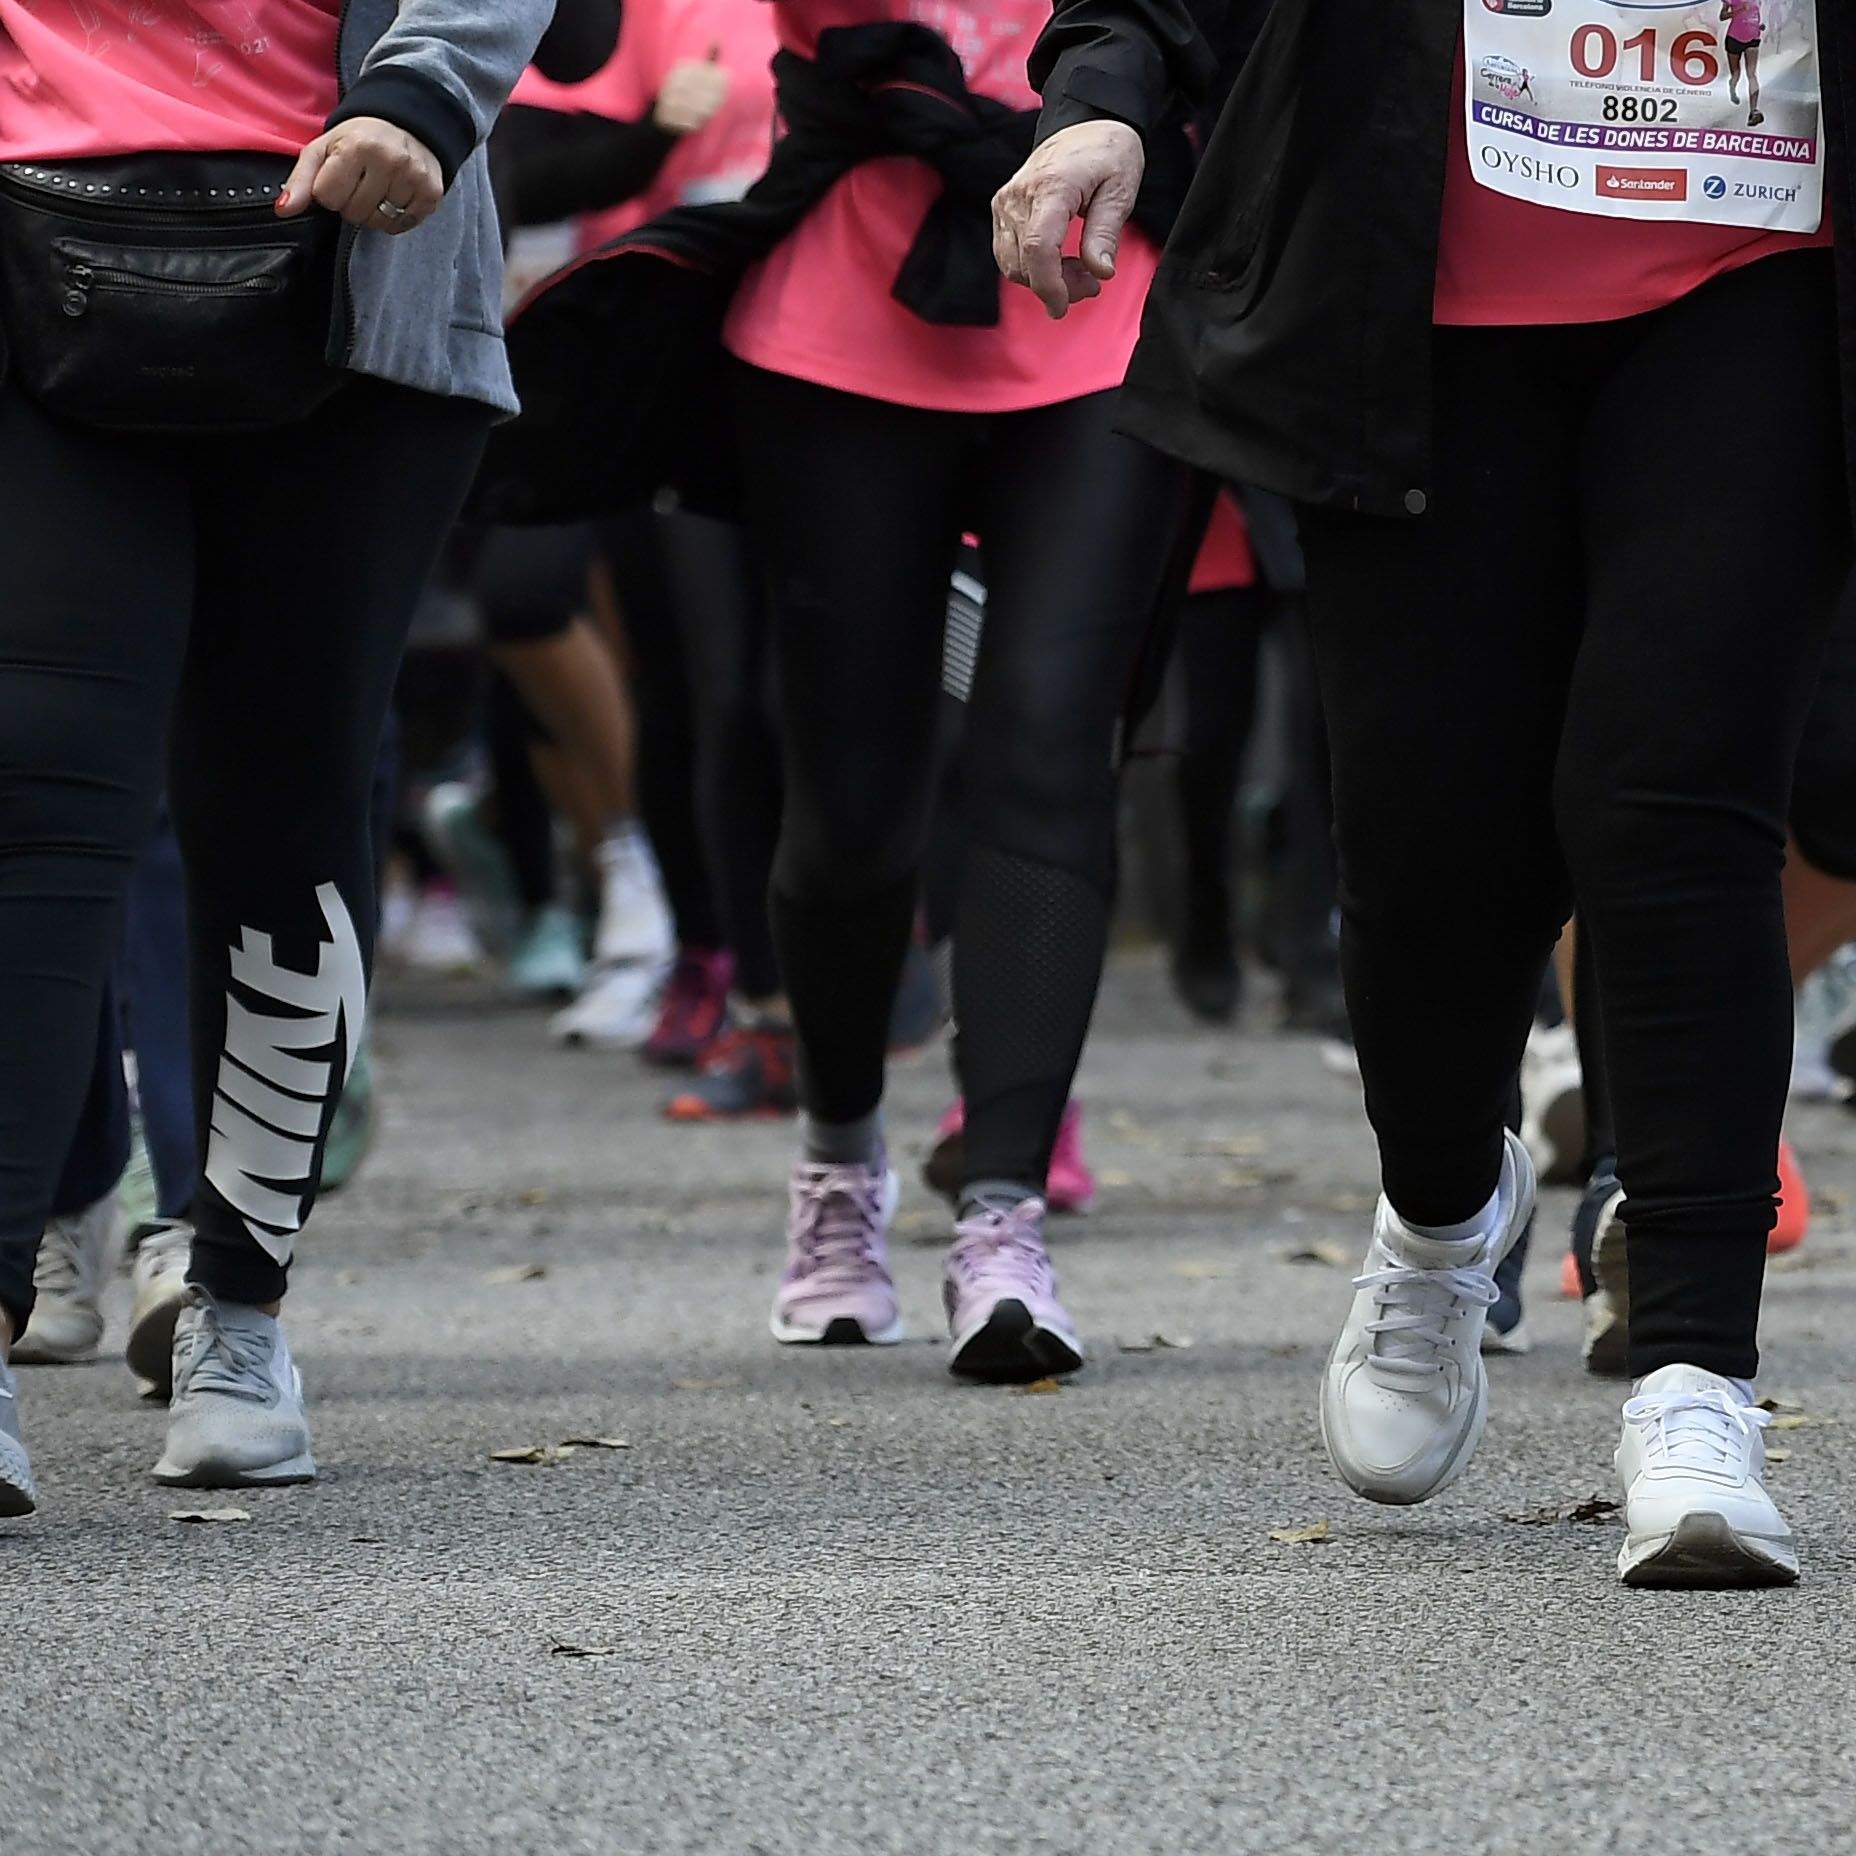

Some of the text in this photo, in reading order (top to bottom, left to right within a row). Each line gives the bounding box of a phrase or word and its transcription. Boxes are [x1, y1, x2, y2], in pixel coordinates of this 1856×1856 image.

[1570, 23, 1718, 86] 016
[1602, 95, 1678, 122] 8802
[1480, 107, 1811, 159] CURSA DE LES DONES DE BARCELONA
[1481, 145, 1580, 188] OYSHO
[1620, 177, 1675, 192] Santander
[1733, 182, 1797, 202] ZURICH
[204, 881, 365, 1268] NIKE
